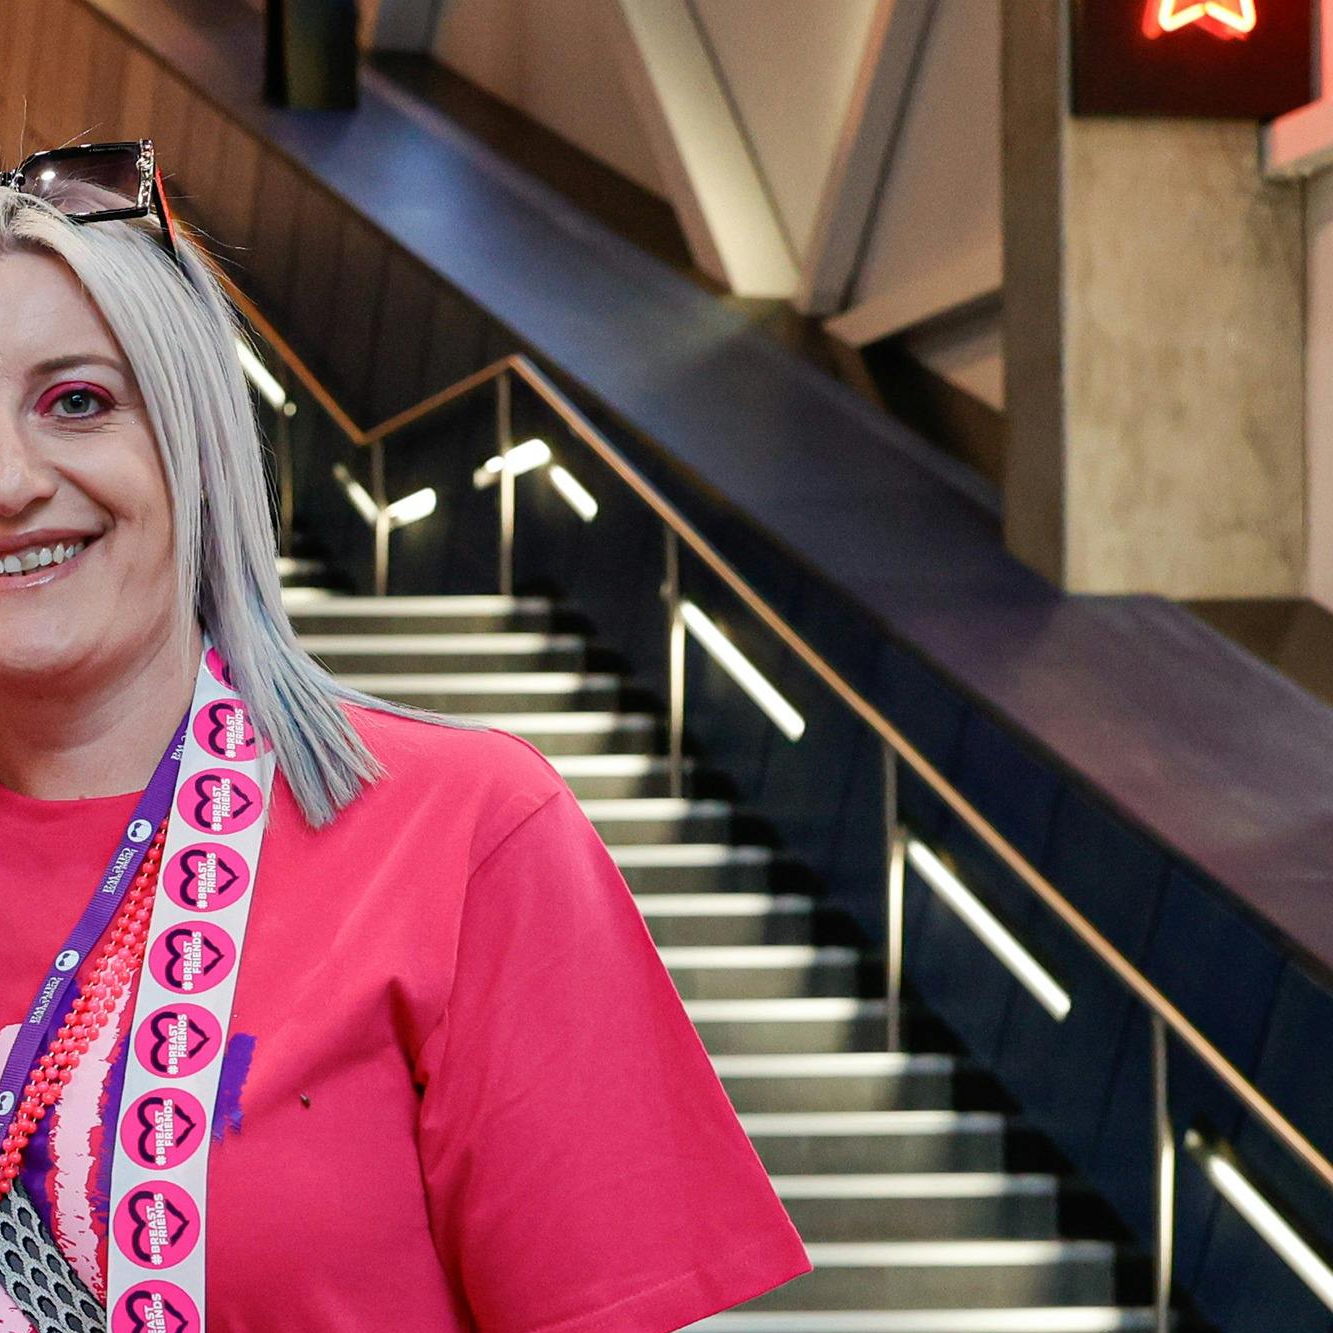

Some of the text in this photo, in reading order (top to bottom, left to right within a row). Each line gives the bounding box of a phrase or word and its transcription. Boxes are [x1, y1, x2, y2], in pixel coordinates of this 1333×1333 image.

[225, 714, 237, 759] #BREAST
[234, 708, 245, 746] FRIENDS
[211, 785, 224, 832] #BREAST
[221, 778, 232, 818] FRIENDS
[101, 847, 131, 895] care wa
[196, 861, 209, 910] #BREAST
[206, 852, 217, 894] FRIENDS
[181, 940, 194, 992] #BREAST
[192, 931, 203, 975] FRIENDS
[167, 1023, 180, 1076] #BREAST
[177, 1014, 189, 1058] FRIENDS
[154, 1110, 167, 1167] #BREAST
[163, 1098, 175, 1148] FRIENDS
[146, 1205, 164, 1266] #BREAST
[153, 1192, 169, 1246] FRIENDS
